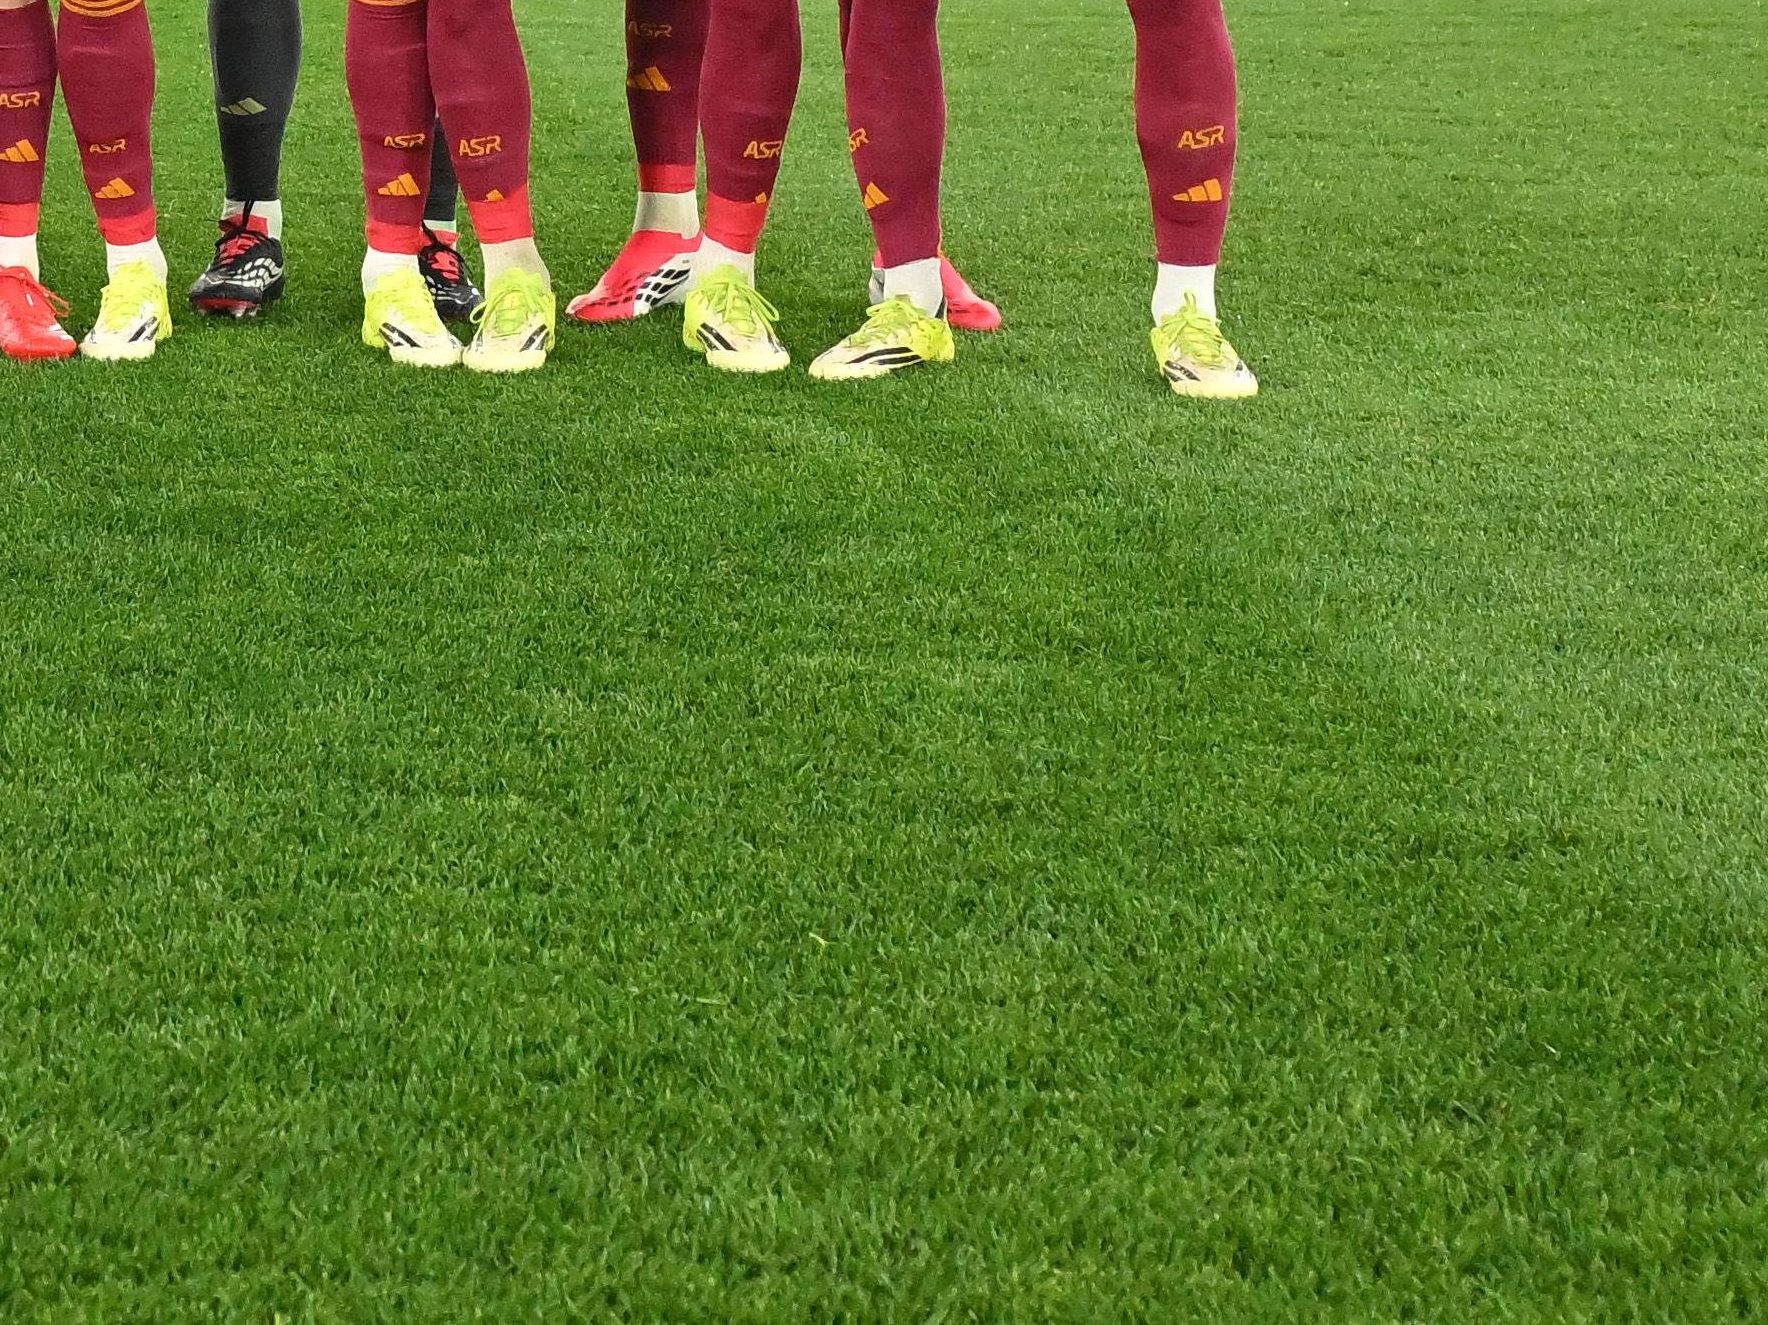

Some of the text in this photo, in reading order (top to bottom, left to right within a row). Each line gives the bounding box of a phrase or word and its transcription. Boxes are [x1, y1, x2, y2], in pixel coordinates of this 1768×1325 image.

[88, 138, 127, 154] ASR
[384, 133, 426, 148] ASR
[459, 135, 502, 157] ASR
[1178, 125, 1225, 149] ASR
